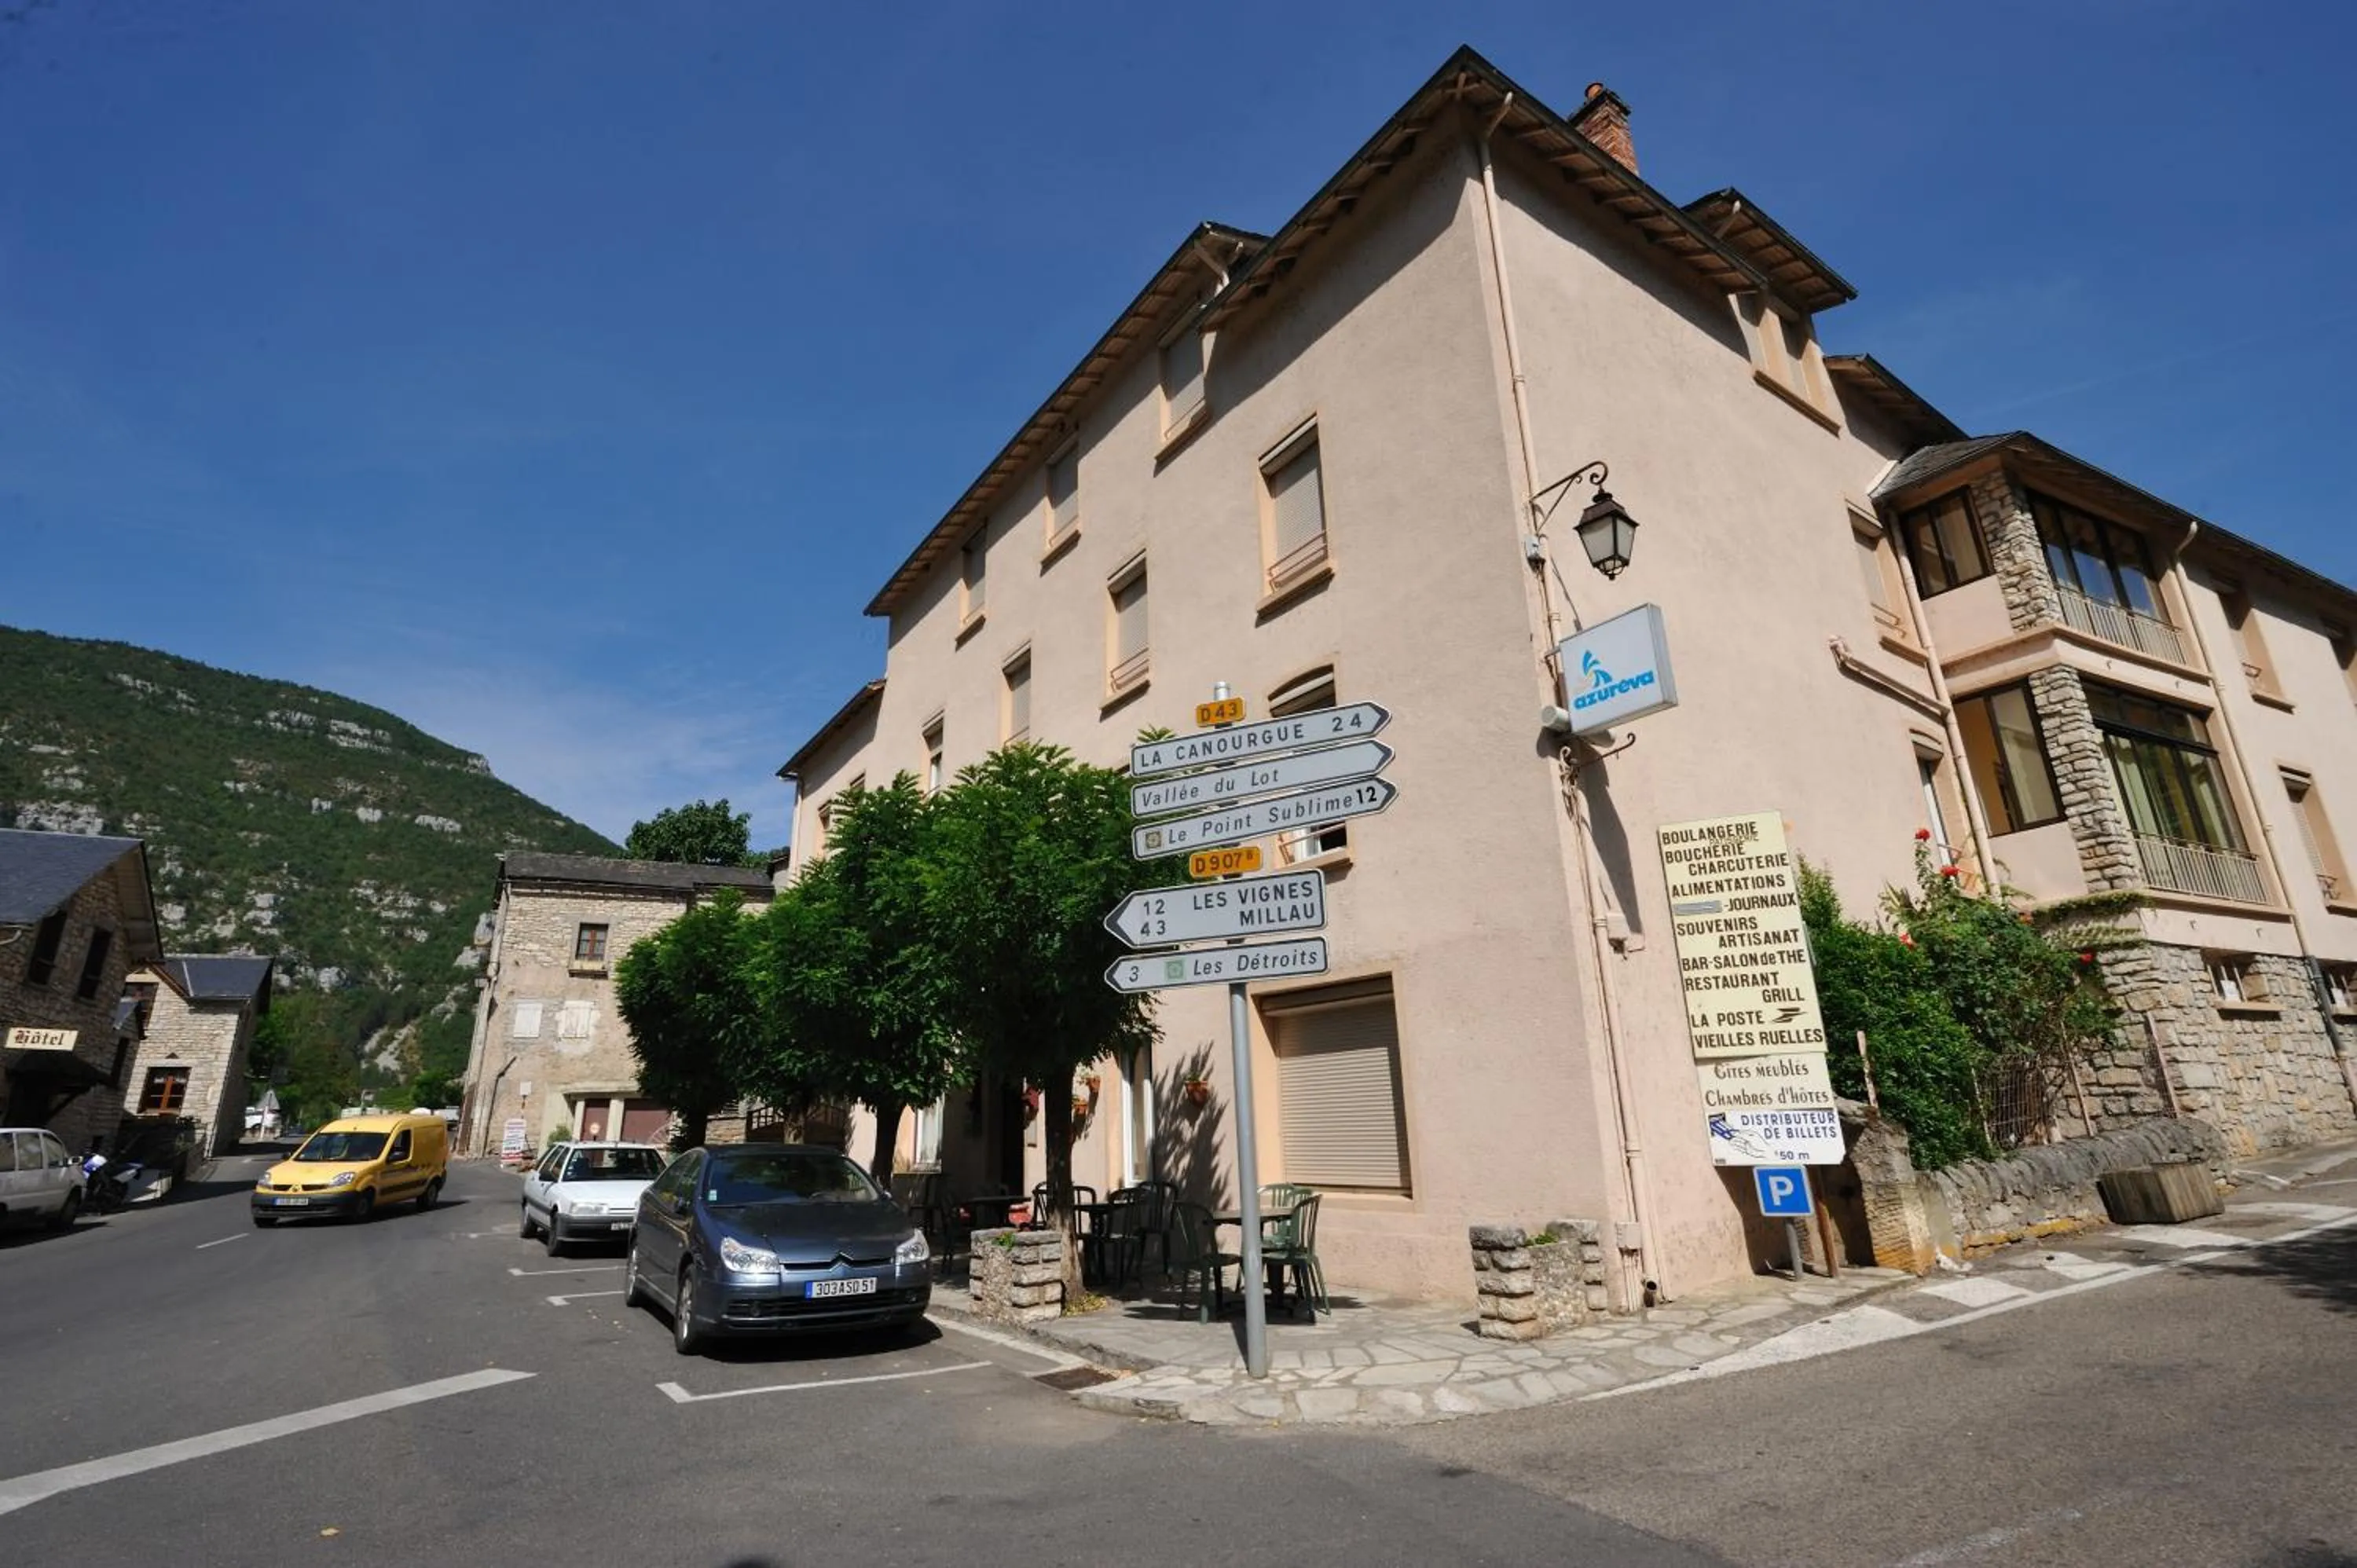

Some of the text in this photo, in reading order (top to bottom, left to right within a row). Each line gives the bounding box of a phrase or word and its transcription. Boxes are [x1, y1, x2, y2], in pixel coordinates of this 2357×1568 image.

[1574, 670, 1655, 709] azureva
[1141, 713, 1362, 768] LA CANOURGUE 24
[1142, 769, 1278, 808] Vallée du Lot
[1168, 786, 1377, 844] Le Point Sublime 12
[1662, 821, 1759, 845] BOULANGERIE
[1665, 843, 1746, 864] BOUCHERIE
[1688, 852, 1790, 877] CHARCUTERIE
[1671, 874, 1786, 898] ALIMENTATIONS
[1143, 881, 1314, 916] 12 LES VIGNES
[1140, 903, 1315, 937] 43 MILLAU
[1676, 916, 1758, 936] SOUVENIRS
[1718, 928, 1799, 949] ARTISANAT
[1129, 951, 1318, 983] 3 Les Détroits
[1760, 951, 1776, 965] de
[1776, 948, 1806, 965] THE
[1684, 971, 1780, 991] RESTAURANT
[1761, 987, 1805, 1003] GRILL
[1691, 1009, 1765, 1028] LA POSTE
[15, 1030, 65, 1046] Hôtel
[1695, 1028, 1824, 1048] VIEILLES RUELLES
[1741, 1112, 1836, 1126] DISTRIBUTEUR
[1764, 1126, 1837, 1139] DE BILLETS
[1798, 1152, 1809, 1160] m
[1769, 1176, 1794, 1206] P
